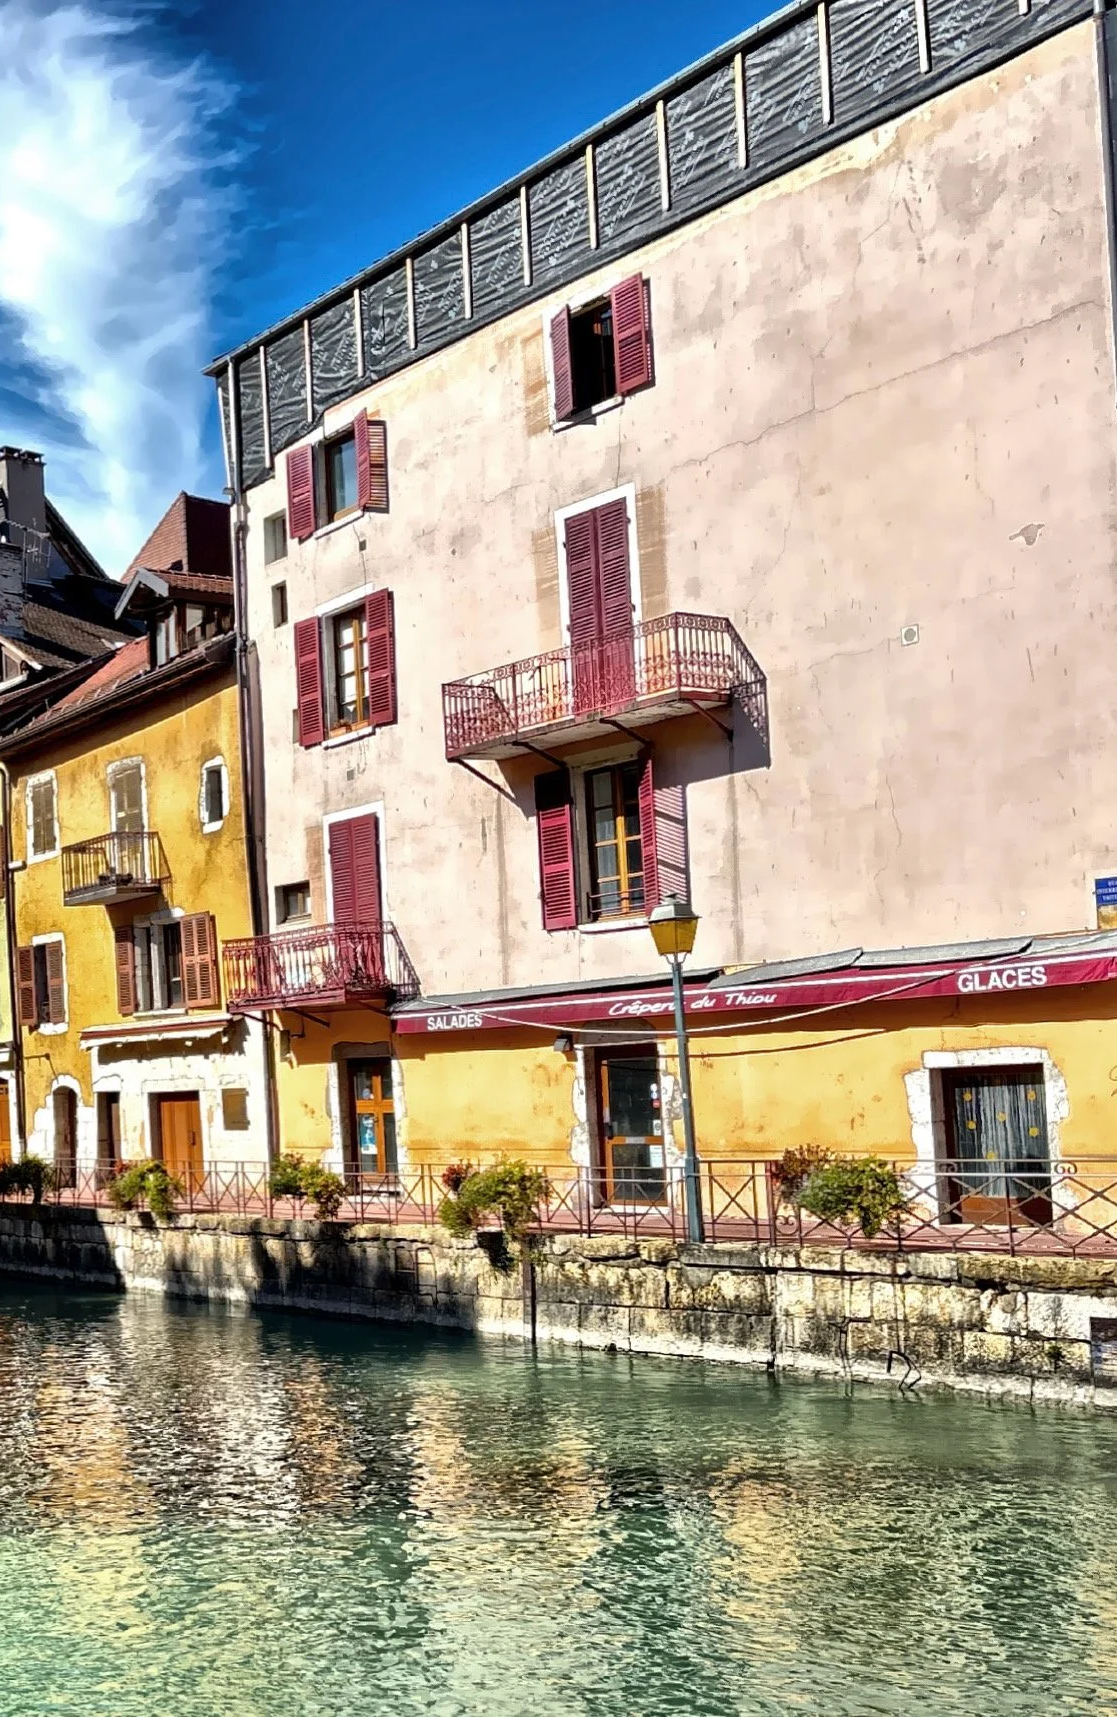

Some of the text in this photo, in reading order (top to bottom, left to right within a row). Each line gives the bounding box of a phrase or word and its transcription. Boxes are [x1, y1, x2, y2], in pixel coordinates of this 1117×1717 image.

[957, 966, 1048, 993] GLACES
[690, 995, 717, 1009] du
[724, 991, 777, 1006] Thiou
[427, 1013, 483, 1031] SALADES
